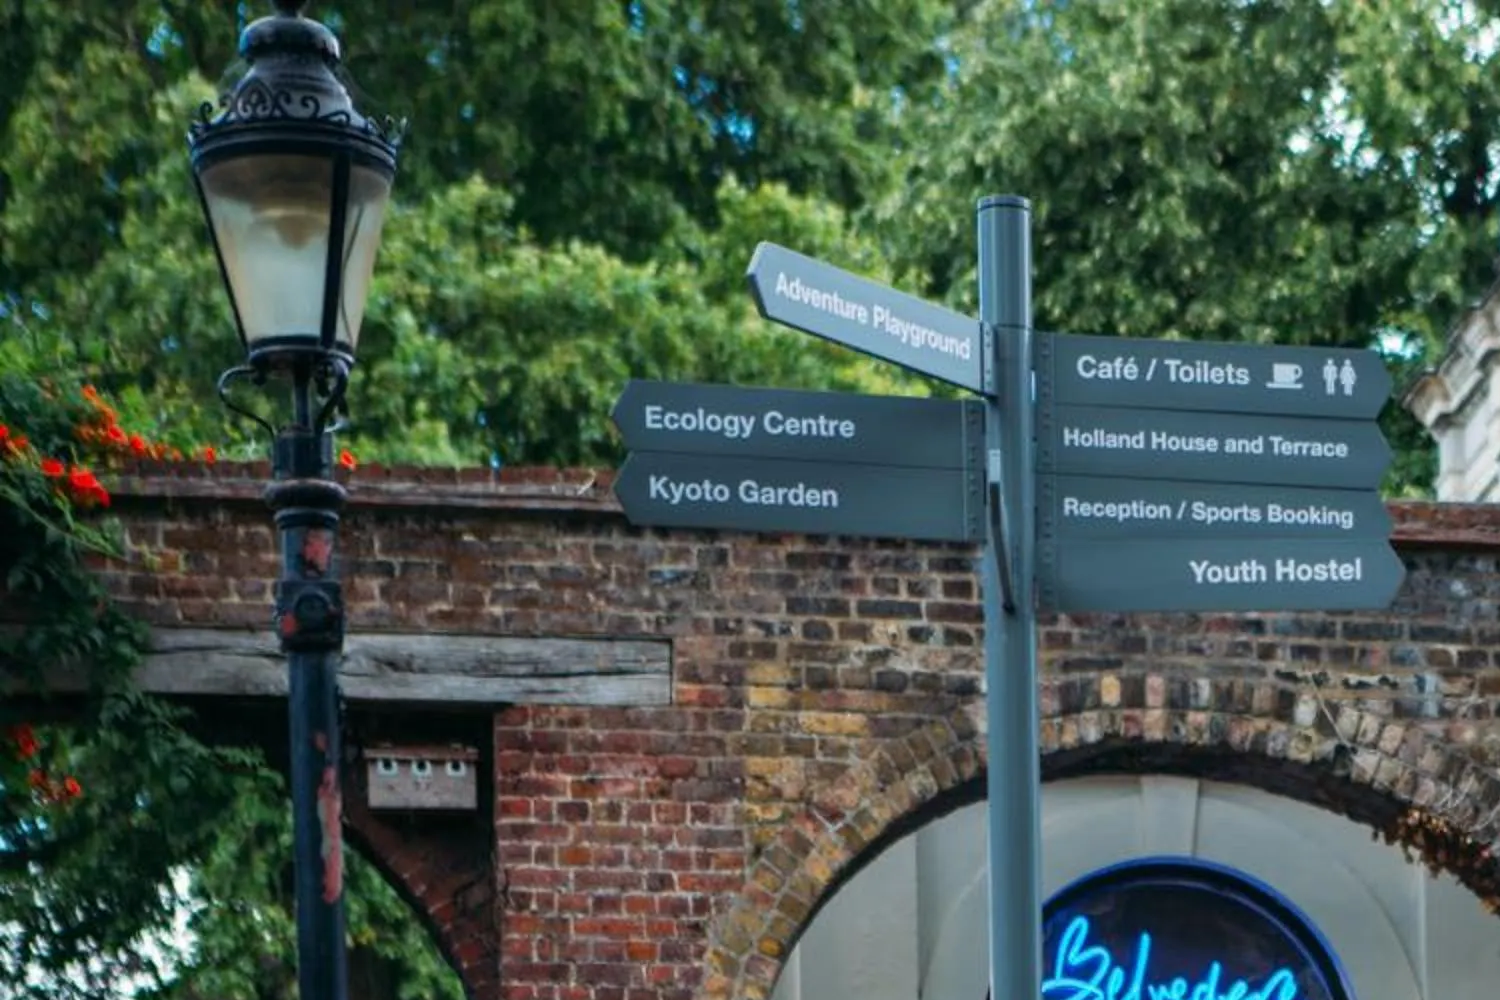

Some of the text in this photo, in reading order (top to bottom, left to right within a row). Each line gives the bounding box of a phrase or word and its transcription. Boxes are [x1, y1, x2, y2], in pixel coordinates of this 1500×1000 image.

[775, 271, 971, 360] Adventure Playground
[1076, 354, 1251, 385] Café / Toilets
[645, 405, 855, 439] Ecology Centre
[1063, 427, 1349, 458] Holland House and Terrace
[649, 474, 839, 508] Kyoto Garden
[1063, 497, 1354, 530] Reception / Sports Booking
[1189, 557, 1362, 584] Youth Hostel
